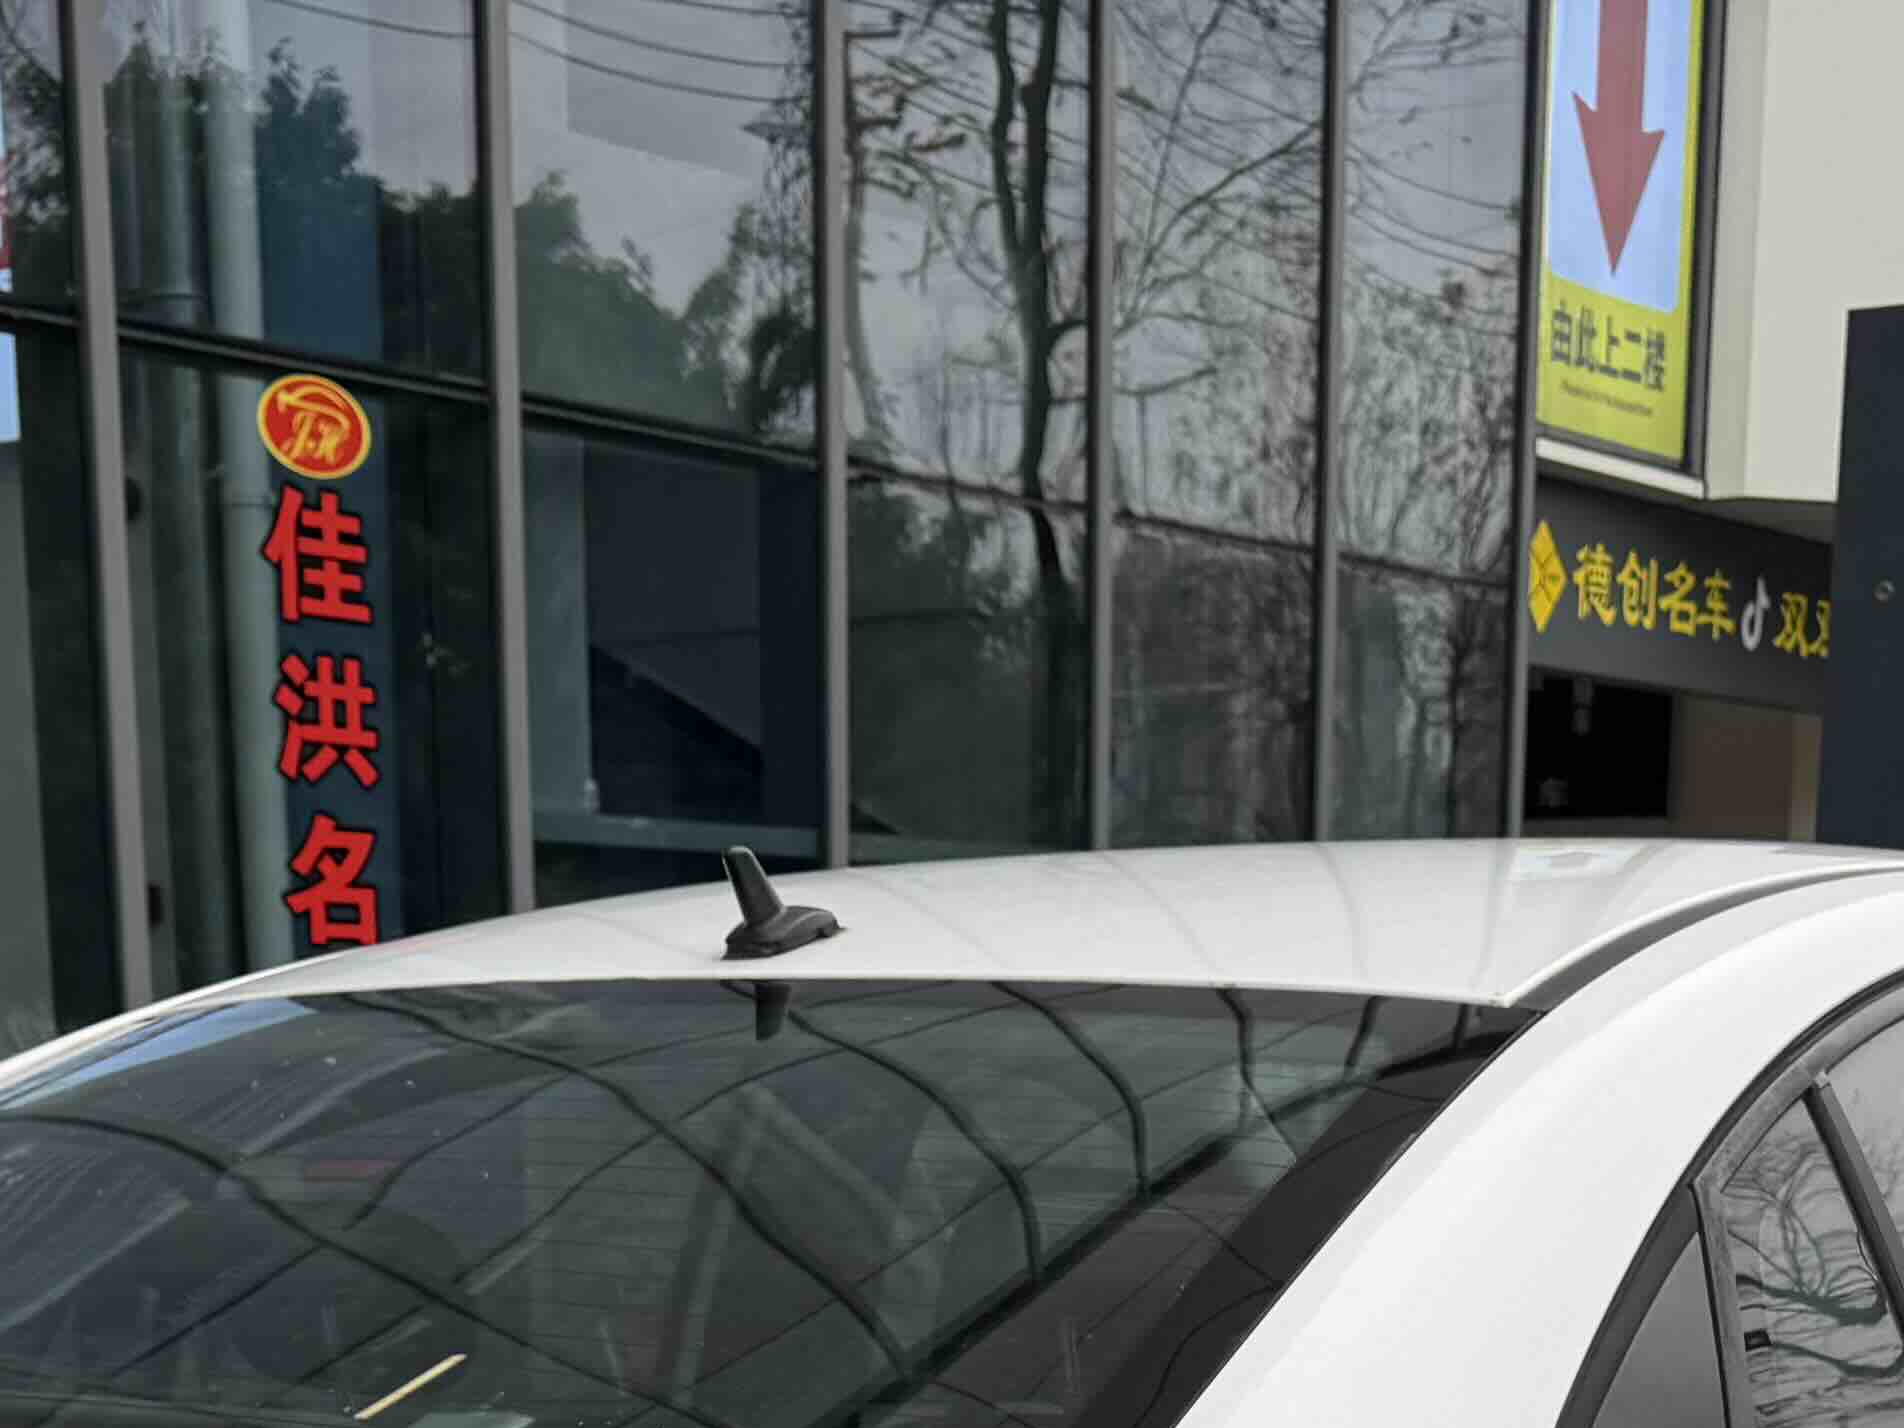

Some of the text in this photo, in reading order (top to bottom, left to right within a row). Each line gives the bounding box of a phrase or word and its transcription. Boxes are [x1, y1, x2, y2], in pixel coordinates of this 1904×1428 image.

[262, 486, 380, 946] 佳洪名
[1573, 543, 1736, 641] 德创名车
